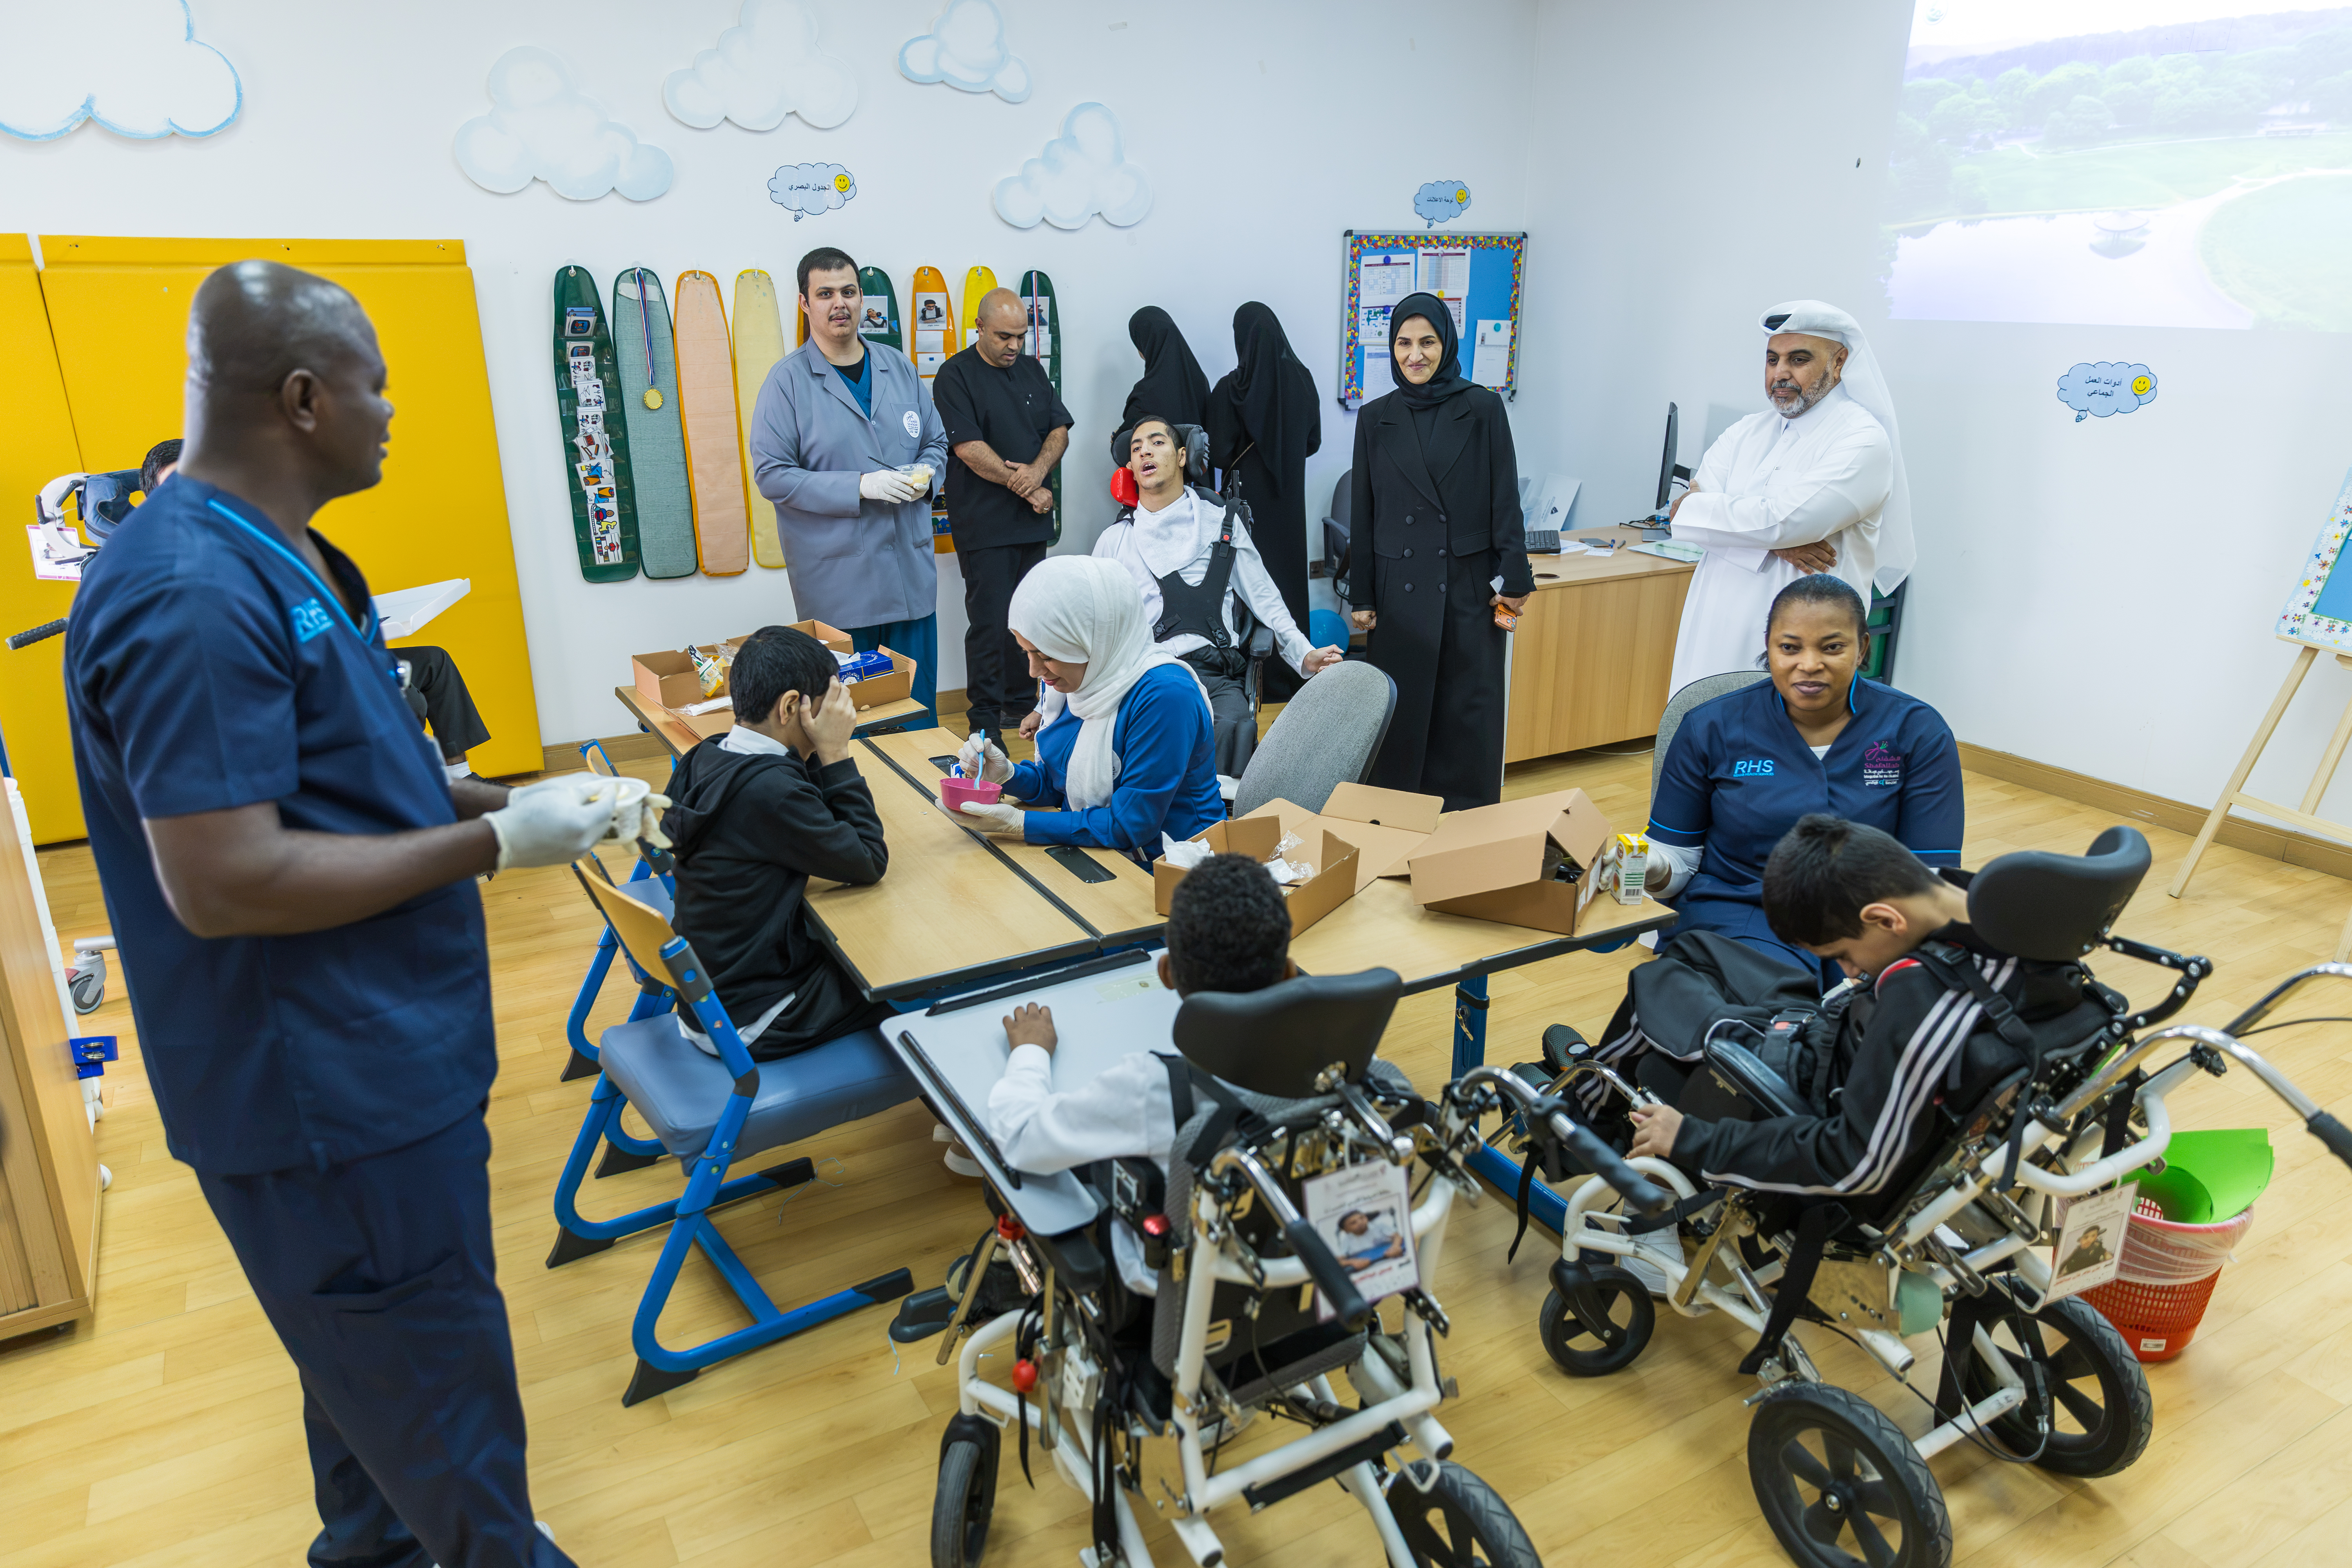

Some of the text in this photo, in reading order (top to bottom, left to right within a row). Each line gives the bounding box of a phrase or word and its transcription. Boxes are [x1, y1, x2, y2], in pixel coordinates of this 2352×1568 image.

[2103, 378, 2122, 387] أدوات
[2087, 389, 2114, 397] الجماعي
[1734, 760, 1774, 774] RHS
